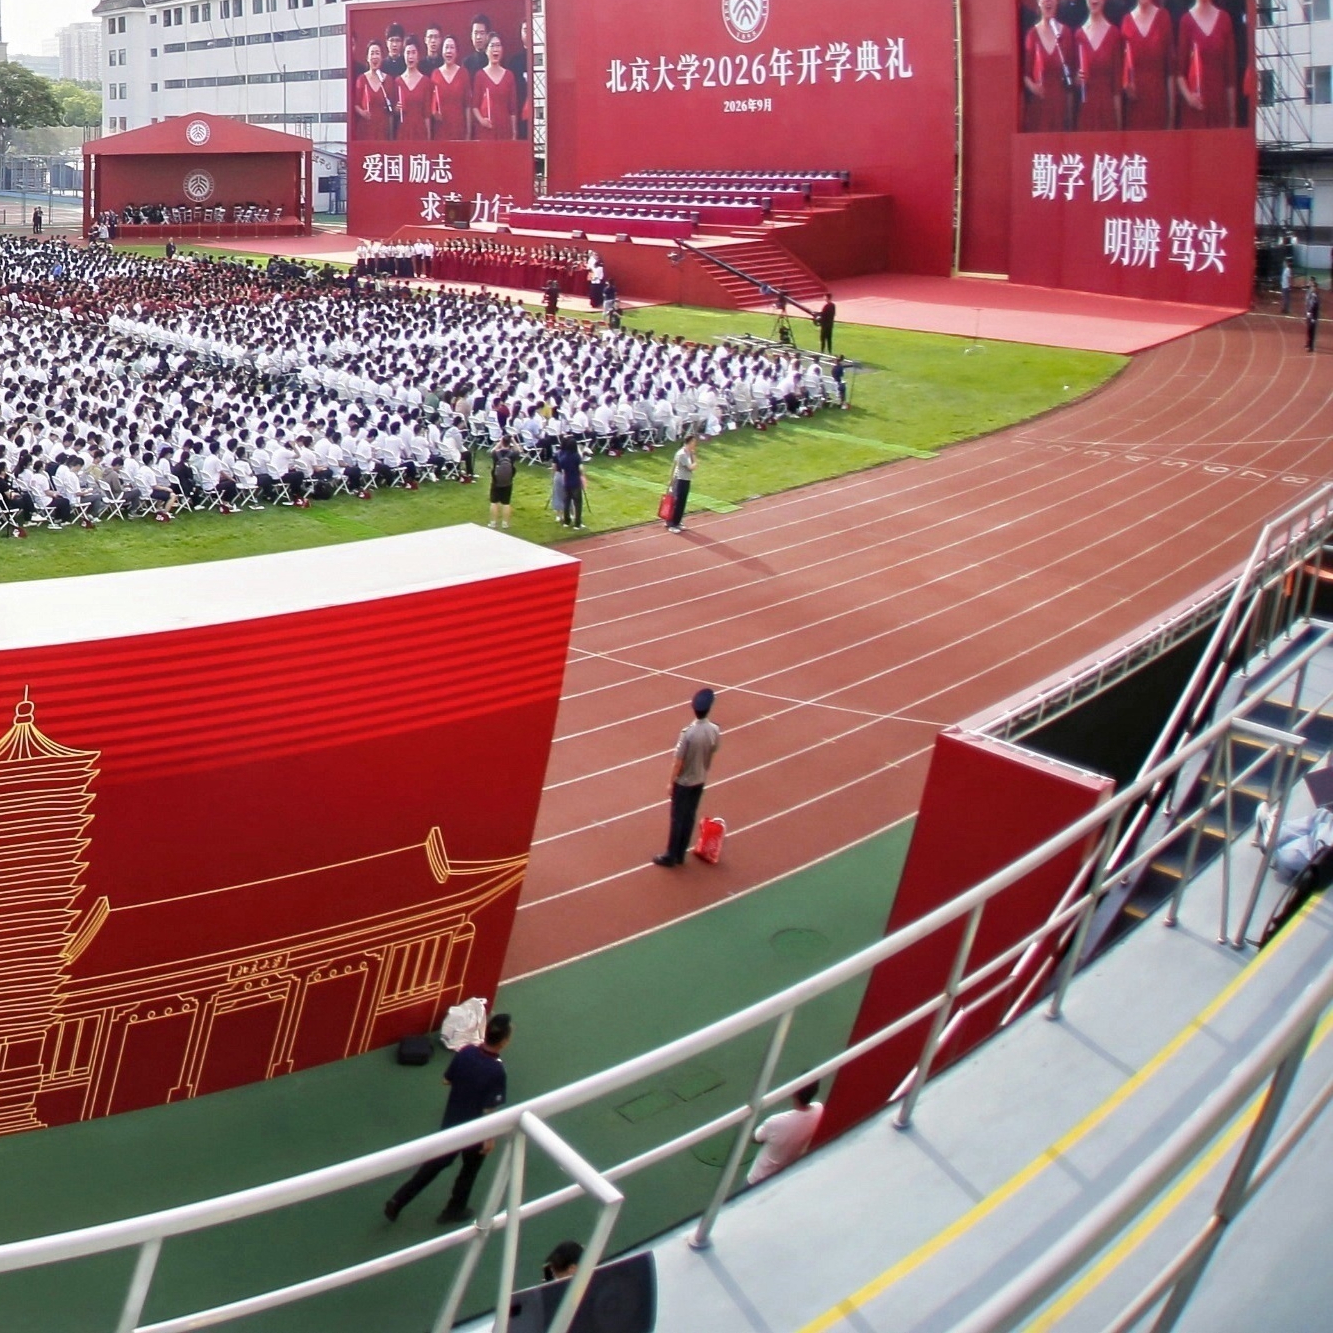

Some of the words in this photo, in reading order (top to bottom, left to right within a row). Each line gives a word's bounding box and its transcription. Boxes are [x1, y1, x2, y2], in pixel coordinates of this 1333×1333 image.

[606, 37, 913, 94] 北京大学2026年开学典礼
[723, 98, 773, 113] 2026年9月
[362, 153, 403, 183] 爱国
[408, 153, 453, 184] 励志
[1032, 153, 1085, 201] 勤学
[1091, 153, 1149, 203] 修德
[470, 192, 514, 223] 力行
[1104, 217, 1161, 268] 明辨
[1169, 219, 1228, 273] 笃实
